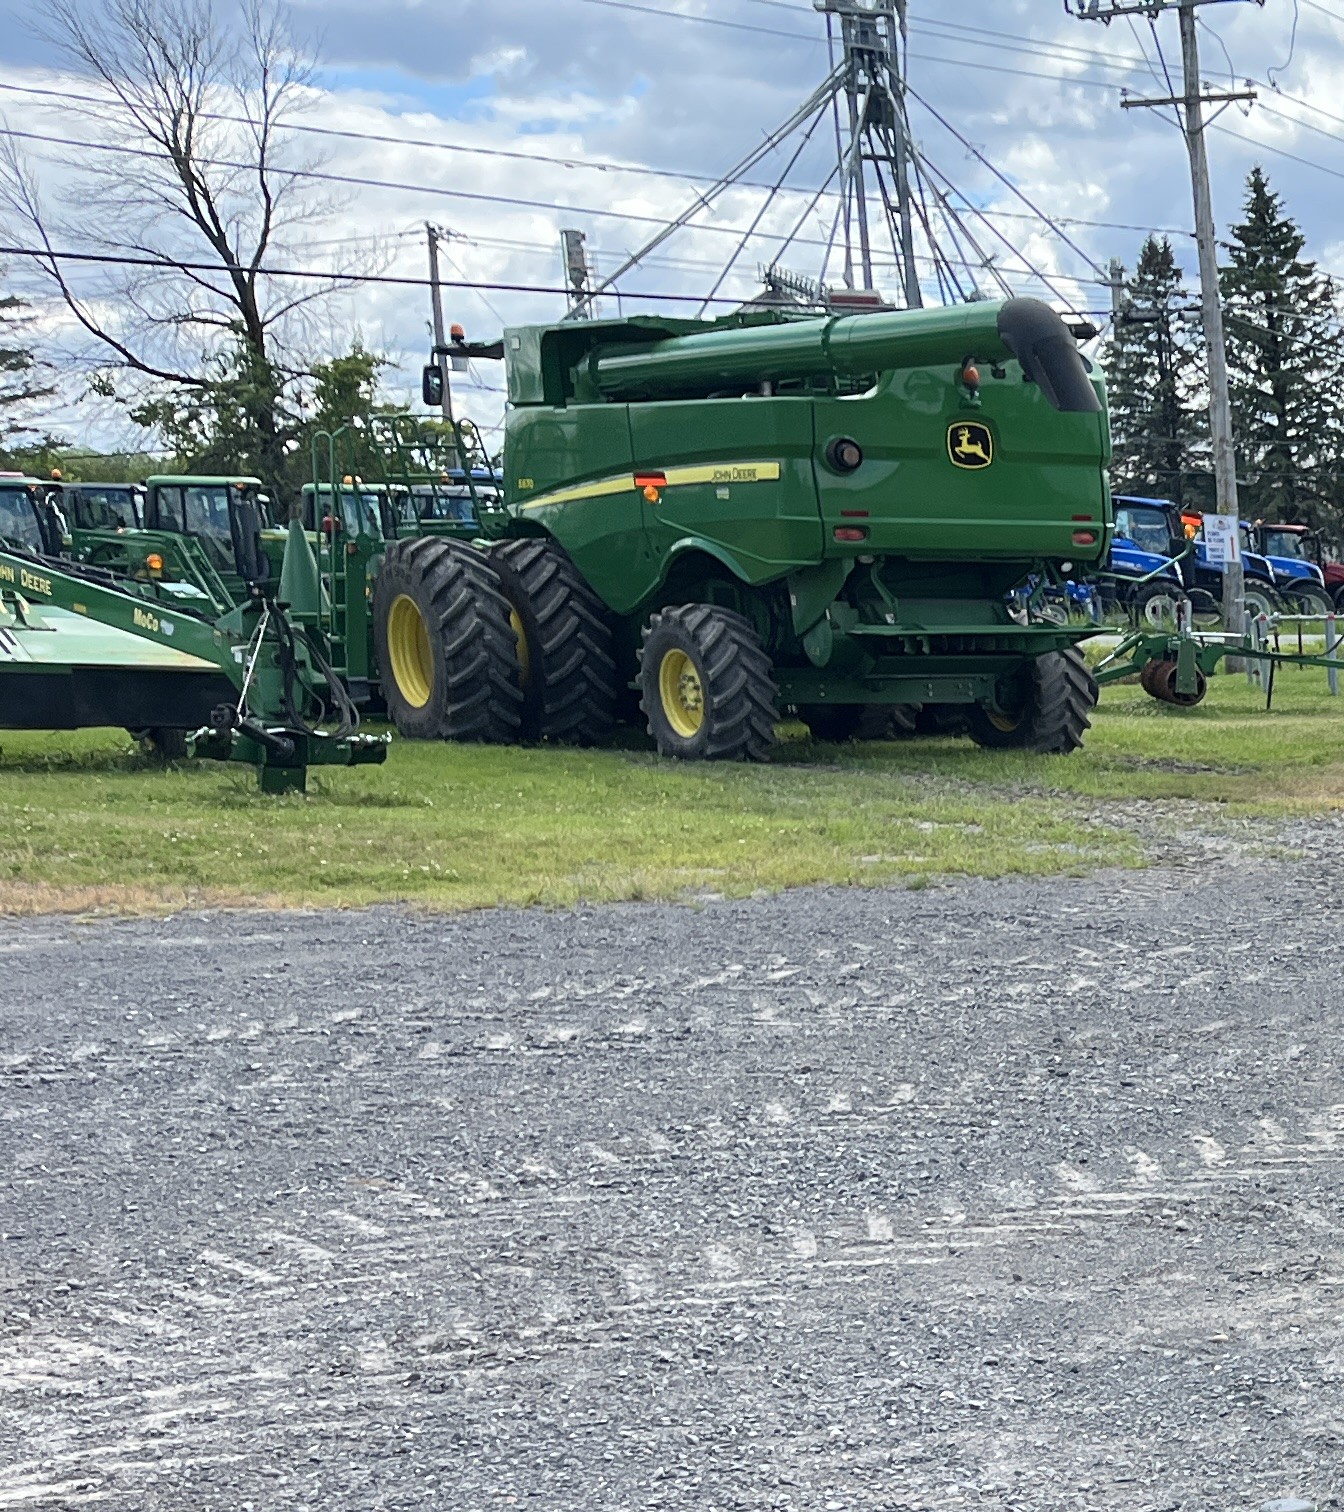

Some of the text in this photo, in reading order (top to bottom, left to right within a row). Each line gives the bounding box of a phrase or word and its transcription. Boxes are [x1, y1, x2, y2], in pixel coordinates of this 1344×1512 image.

[733, 467, 757, 480] DEERE
[20, 568, 52, 596] DEERE
[133, 607, 159, 632] MoCo
